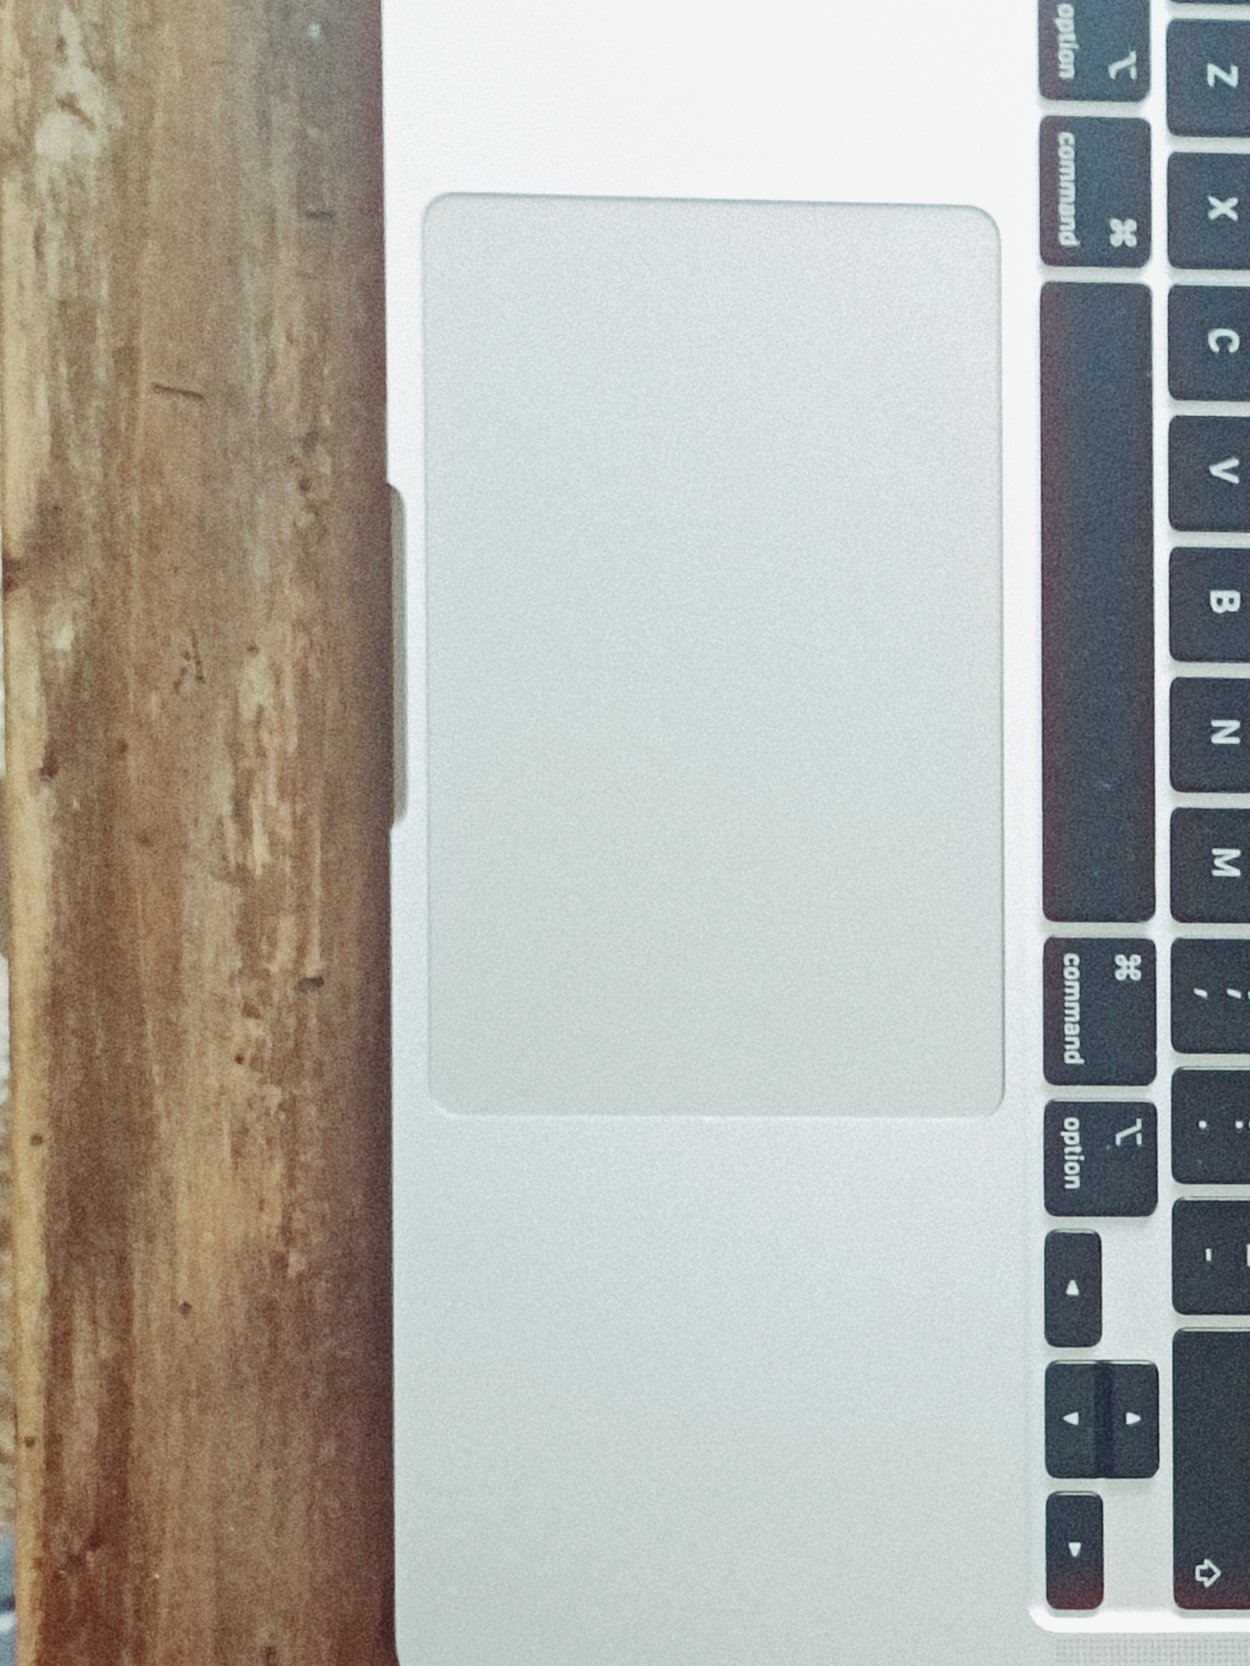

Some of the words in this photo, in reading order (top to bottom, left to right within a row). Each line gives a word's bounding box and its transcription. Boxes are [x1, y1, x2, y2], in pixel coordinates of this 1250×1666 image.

[1053, 3, 1079, 79] option
[1206, 63, 1239, 88] Z
[1057, 131, 1080, 247] command
[1208, 196, 1239, 221] X
[1208, 328, 1240, 353] C
[1209, 458, 1240, 484] V
[1209, 590, 1241, 614] B
[1211, 719, 1241, 745] N
[1211, 848, 1241, 877] M
[1063, 952, 1085, 1065] command
[1060, 1116, 1085, 1190] option
